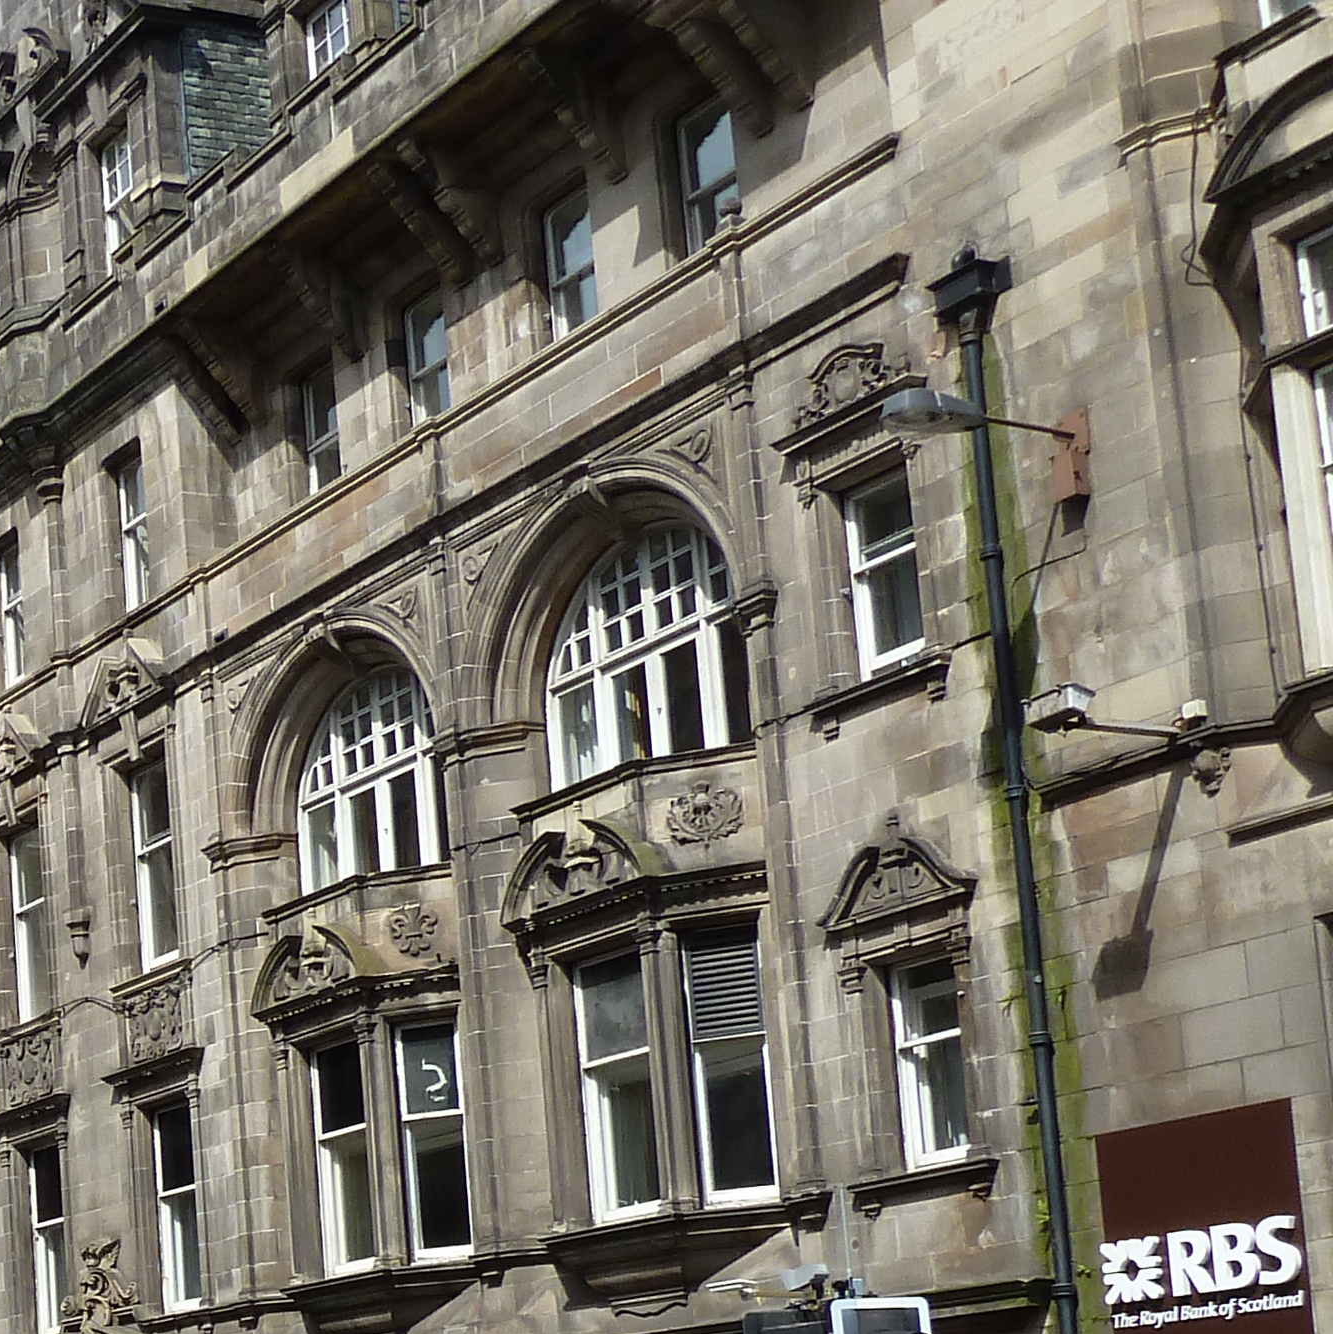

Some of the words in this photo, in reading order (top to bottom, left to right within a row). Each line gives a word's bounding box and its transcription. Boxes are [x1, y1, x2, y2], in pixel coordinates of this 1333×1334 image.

[1166, 1215, 1303, 1297] RBS
[1112, 1313, 1140, 1329] The
[1140, 1306, 1179, 1329] Royal
[1180, 1301, 1218, 1321] Bank
[1219, 1298, 1238, 1320] of
[1237, 1290, 1305, 1315] Scotland
